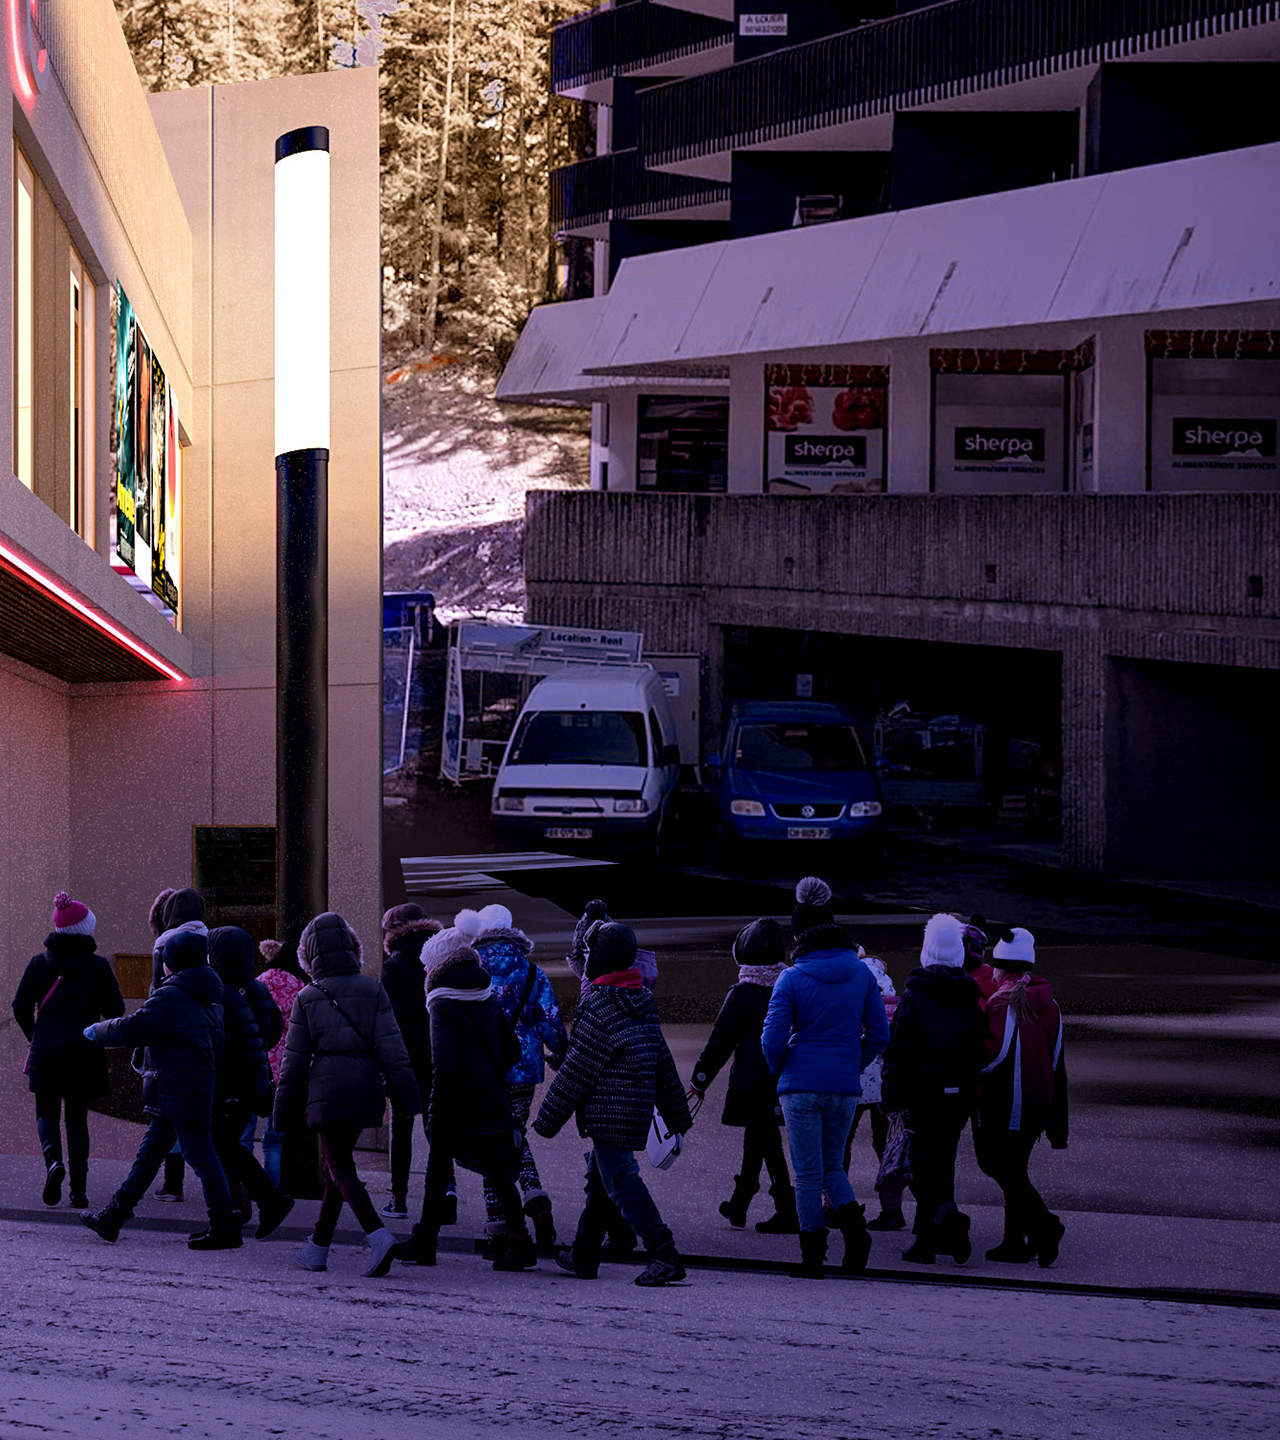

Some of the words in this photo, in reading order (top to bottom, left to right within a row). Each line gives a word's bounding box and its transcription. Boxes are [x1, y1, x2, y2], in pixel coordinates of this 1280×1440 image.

[964, 433, 1033, 454] sherpa
[1184, 424, 1263, 448] sherpa
[793, 440, 855, 460] sherpa
[550, 631, 591, 643] Location
[599, 635, 624, 646] Rent
